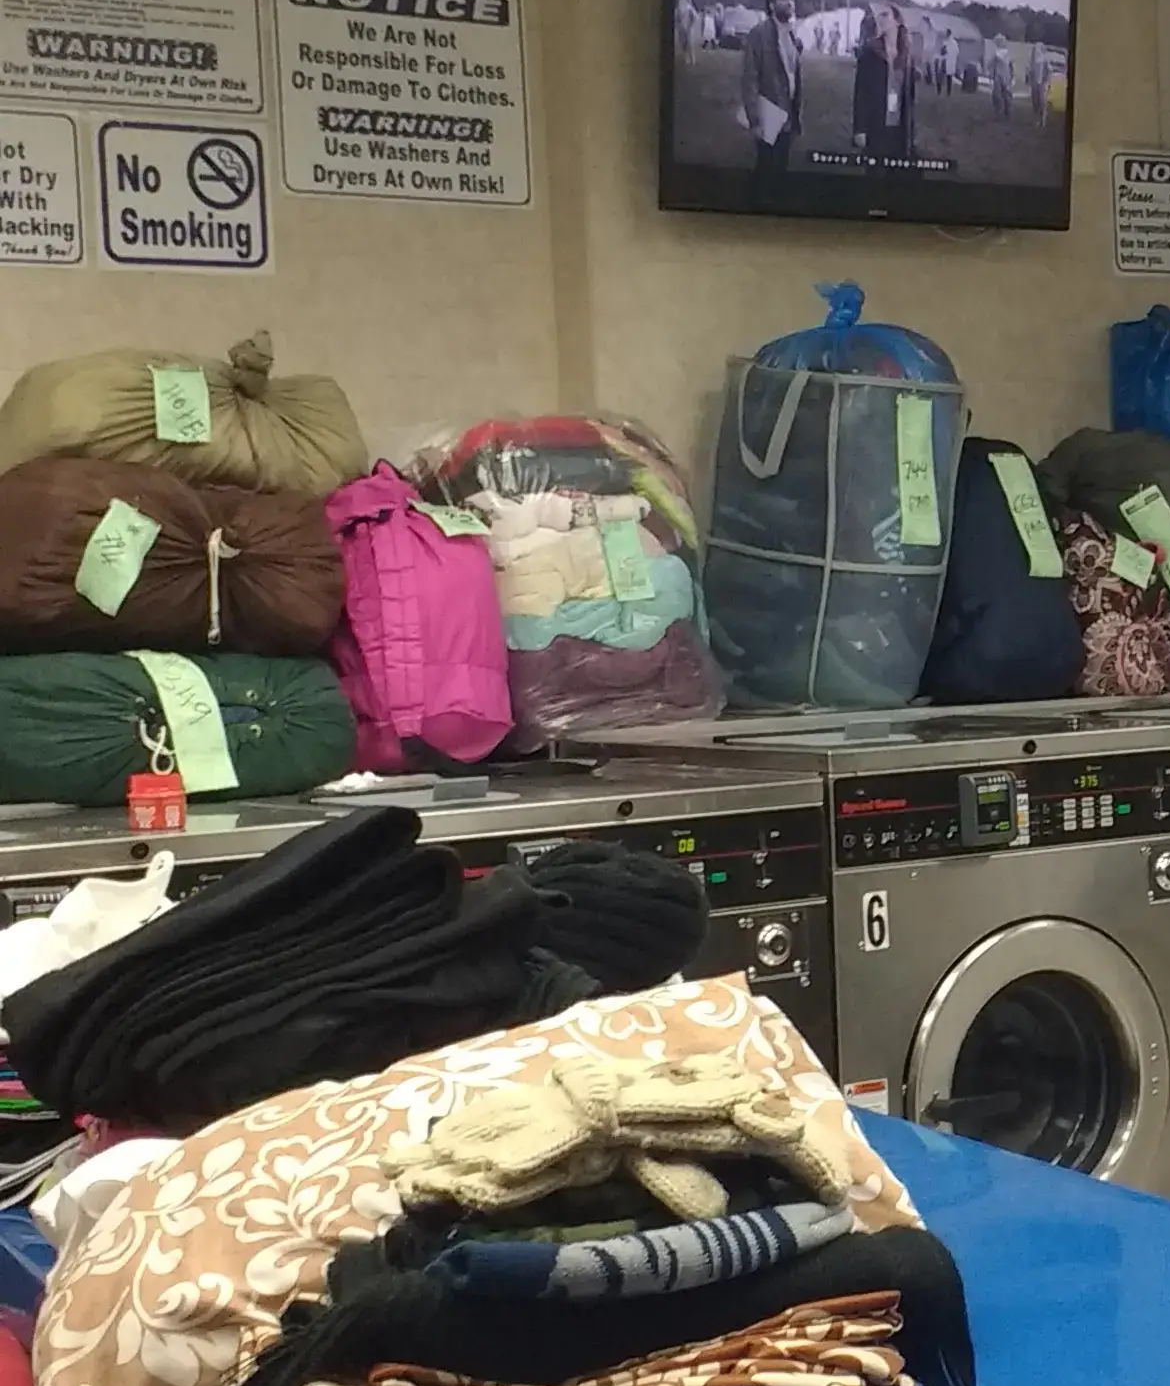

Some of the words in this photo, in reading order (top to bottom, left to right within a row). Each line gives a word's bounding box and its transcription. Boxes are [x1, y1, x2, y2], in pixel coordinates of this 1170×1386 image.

[36, 34, 204, 64] WARNING!
[347, 20, 377, 42] We
[384, 25, 416, 46] Are
[424, 29, 457, 50] Not
[298, 43, 418, 72] Responsible
[426, 55, 456, 76] For
[462, 59, 505, 80] Loss
[3, 63, 29, 75] Use
[33, 63, 89, 80] Washers
[95, 69, 119, 82] And
[125, 70, 165, 88] Dryers
[170, 75, 185, 87] At
[189, 76, 216, 90] Own
[221, 79, 247, 92] Risk
[291, 71, 315, 90] Or
[322, 73, 401, 101] Damage
[408, 80, 431, 100] To
[437, 83, 515, 107] Clothes.
[327, 111, 482, 139] WARNING!
[0, 142, 25, 160] ot
[324, 137, 361, 158] Use
[368, 141, 450, 164] Washers
[456, 147, 491, 166] And
[20, 166, 57, 190] Dry
[116, 153, 161, 193] No
[313, 164, 377, 189] Dryers
[384, 170, 405, 188] At
[411, 171, 452, 191] Own
[459, 174, 505, 194] Risk!
[0, 217, 75, 242] acking
[121, 207, 251, 259] Smoking
[867, 895, 886, 947] 6
